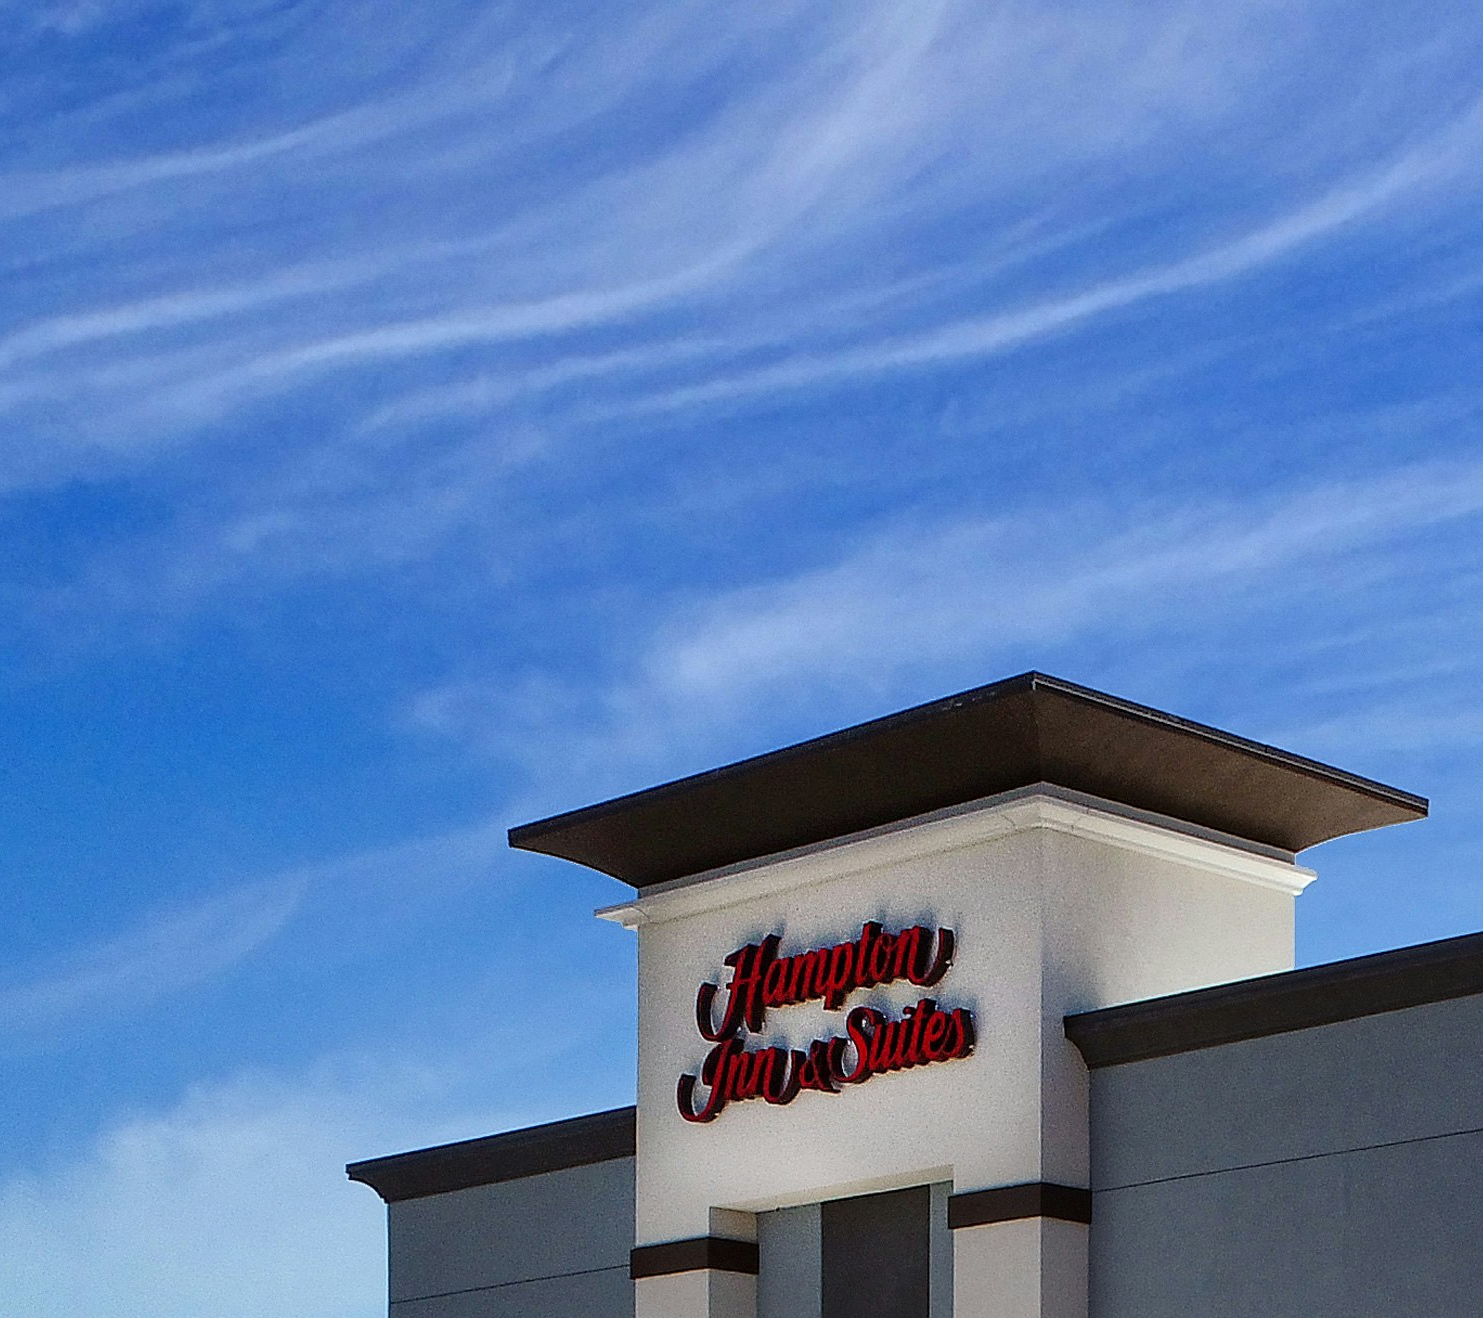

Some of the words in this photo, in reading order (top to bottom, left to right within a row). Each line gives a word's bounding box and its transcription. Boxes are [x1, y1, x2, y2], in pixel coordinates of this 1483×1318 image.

[696, 920, 956, 1042] Hampton
[676, 1038, 807, 1124] Inn
[827, 998, 977, 1084] Suites
